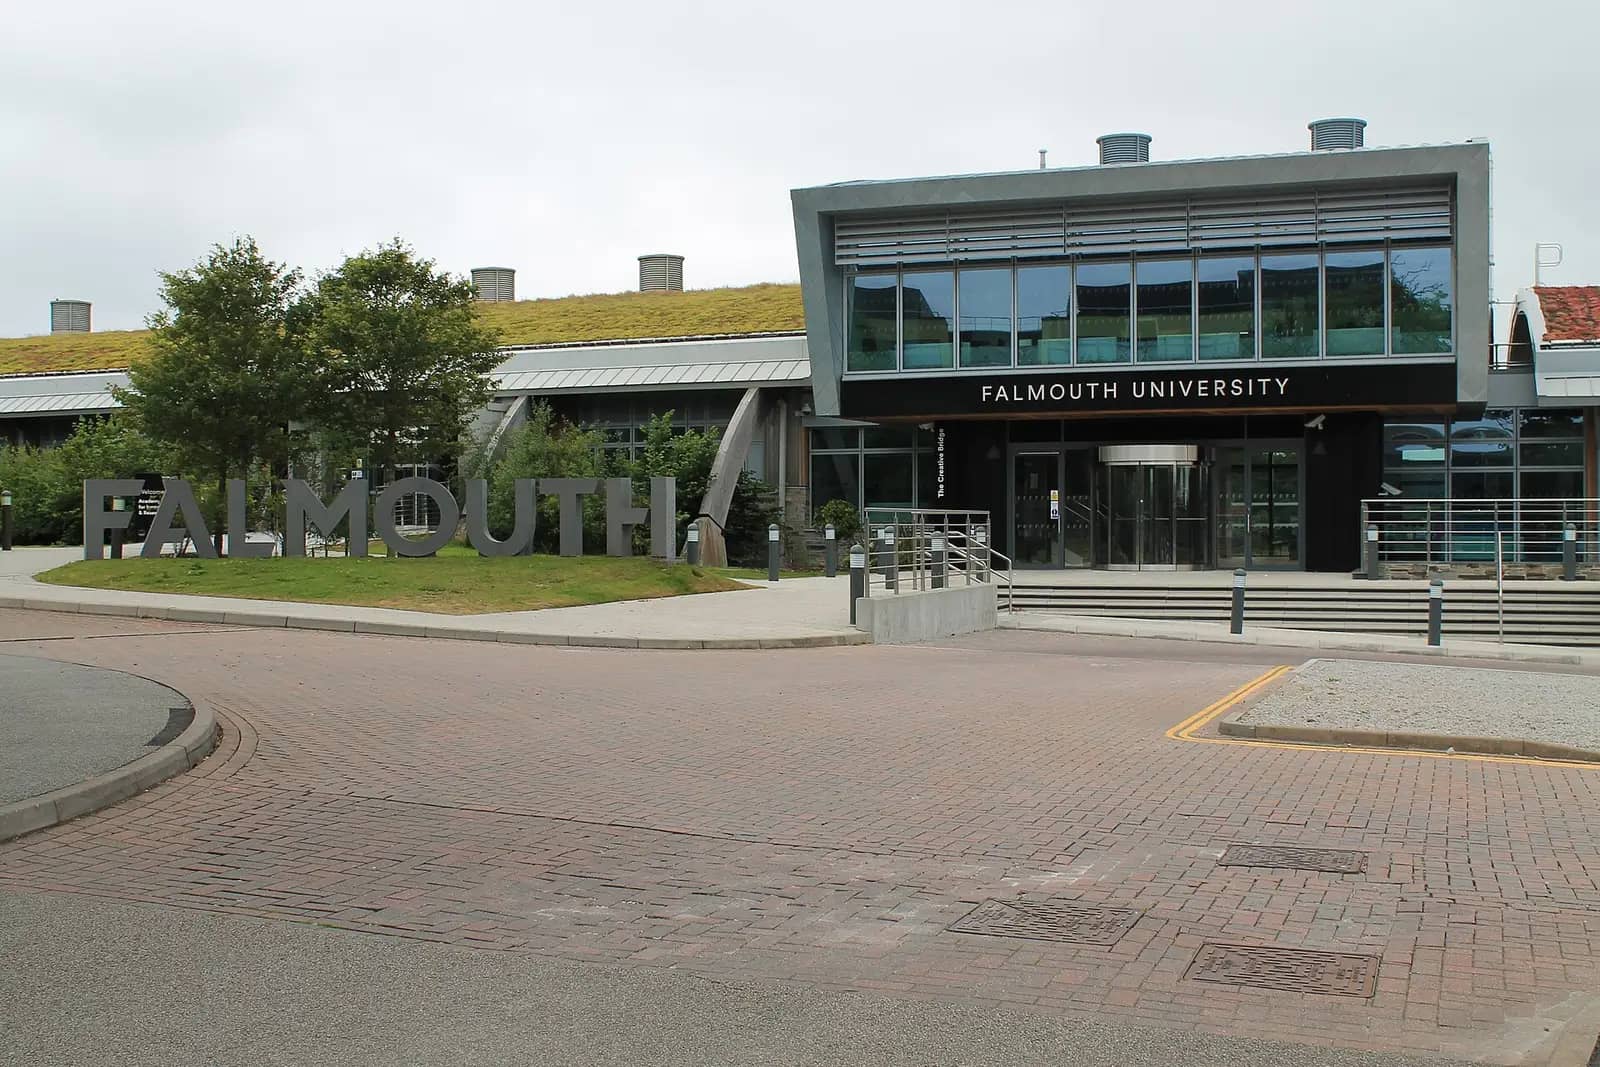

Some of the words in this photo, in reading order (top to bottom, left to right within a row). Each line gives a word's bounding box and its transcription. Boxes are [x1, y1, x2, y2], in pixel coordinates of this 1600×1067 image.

[982, 382, 1117, 402] FALMOUTH
[1132, 378, 1289, 398] UNIVERSITY
[937, 428, 946, 452] Bridge
[937, 452, 945, 483] Creative
[937, 484, 945, 499] The
[83, 477, 677, 561] FALMOUTH
